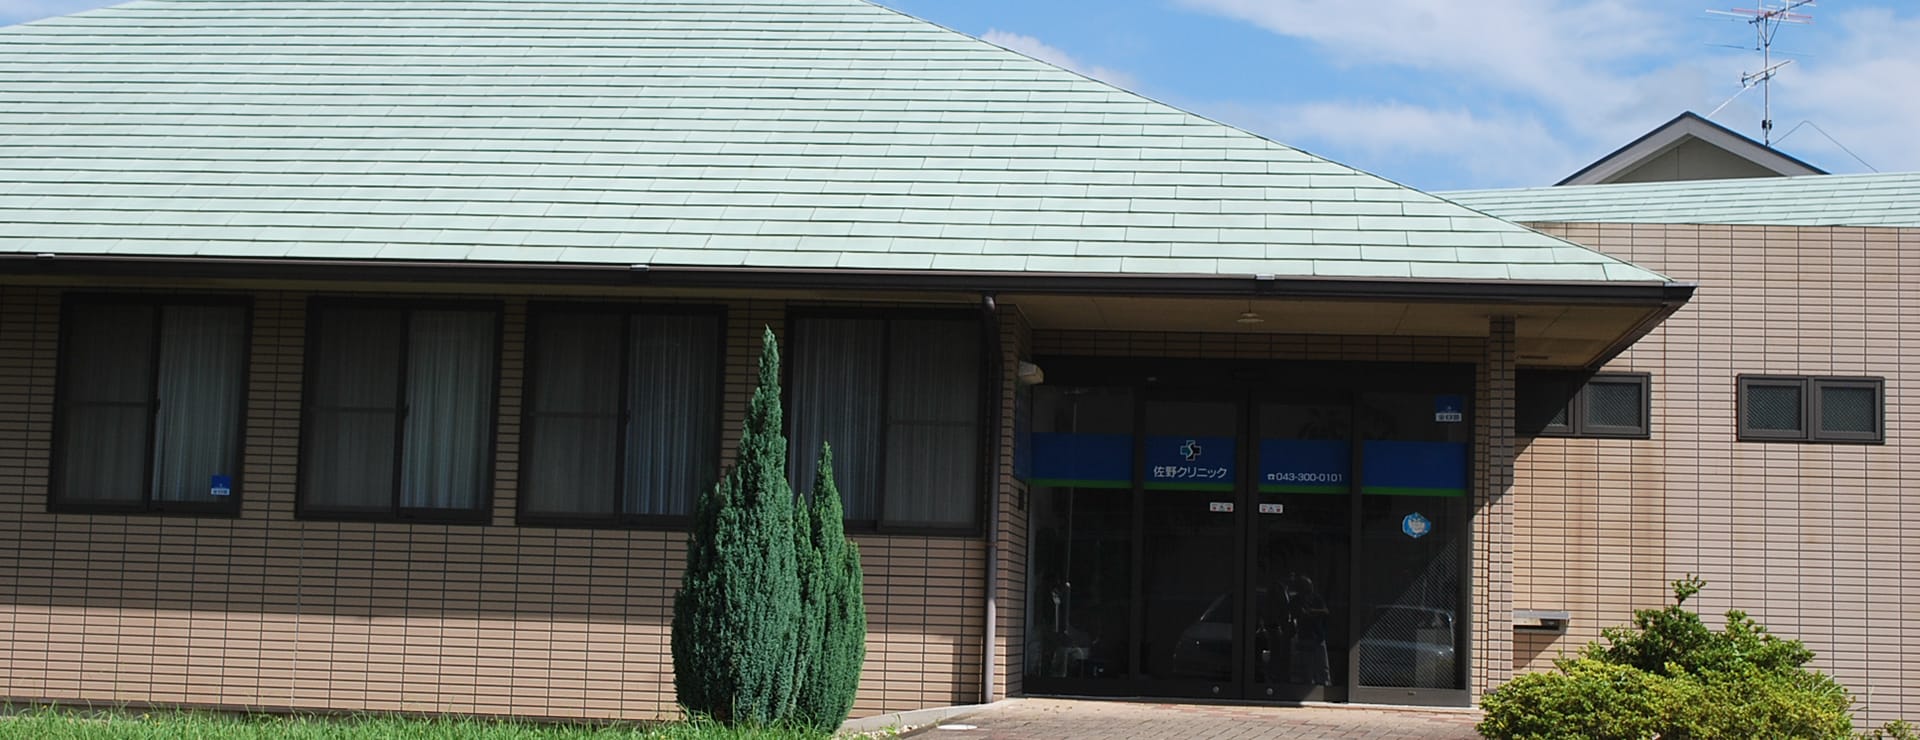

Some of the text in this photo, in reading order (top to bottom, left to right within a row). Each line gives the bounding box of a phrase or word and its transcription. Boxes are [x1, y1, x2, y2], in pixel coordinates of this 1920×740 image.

[1153, 466, 1227, 478] 佐野クリニック
[1275, 472, 1342, 482] 043-300-0101
